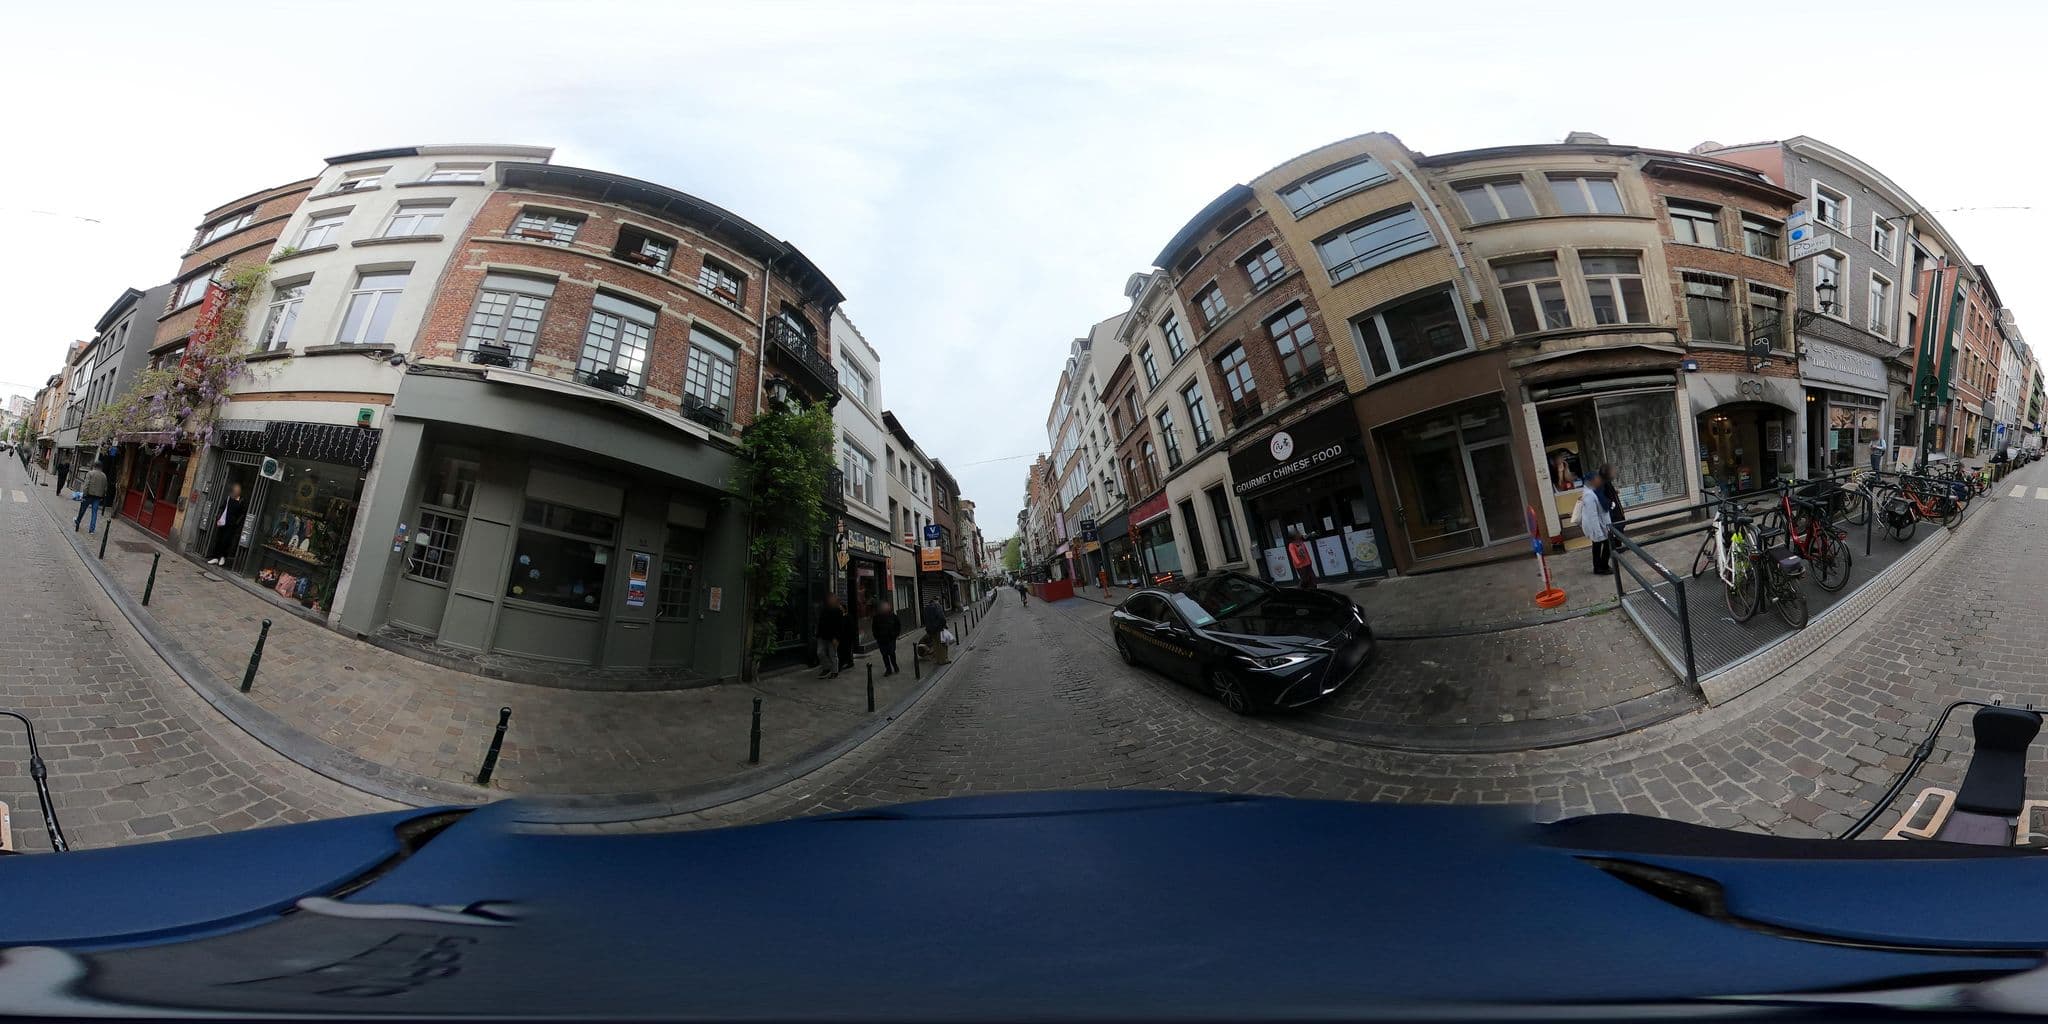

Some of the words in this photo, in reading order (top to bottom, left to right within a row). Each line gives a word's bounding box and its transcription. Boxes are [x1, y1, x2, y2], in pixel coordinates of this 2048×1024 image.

[1236, 472, 1272, 493] GOURMET
[1273, 457, 1310, 479] CHINESE
[1312, 444, 1342, 465] FOOD
